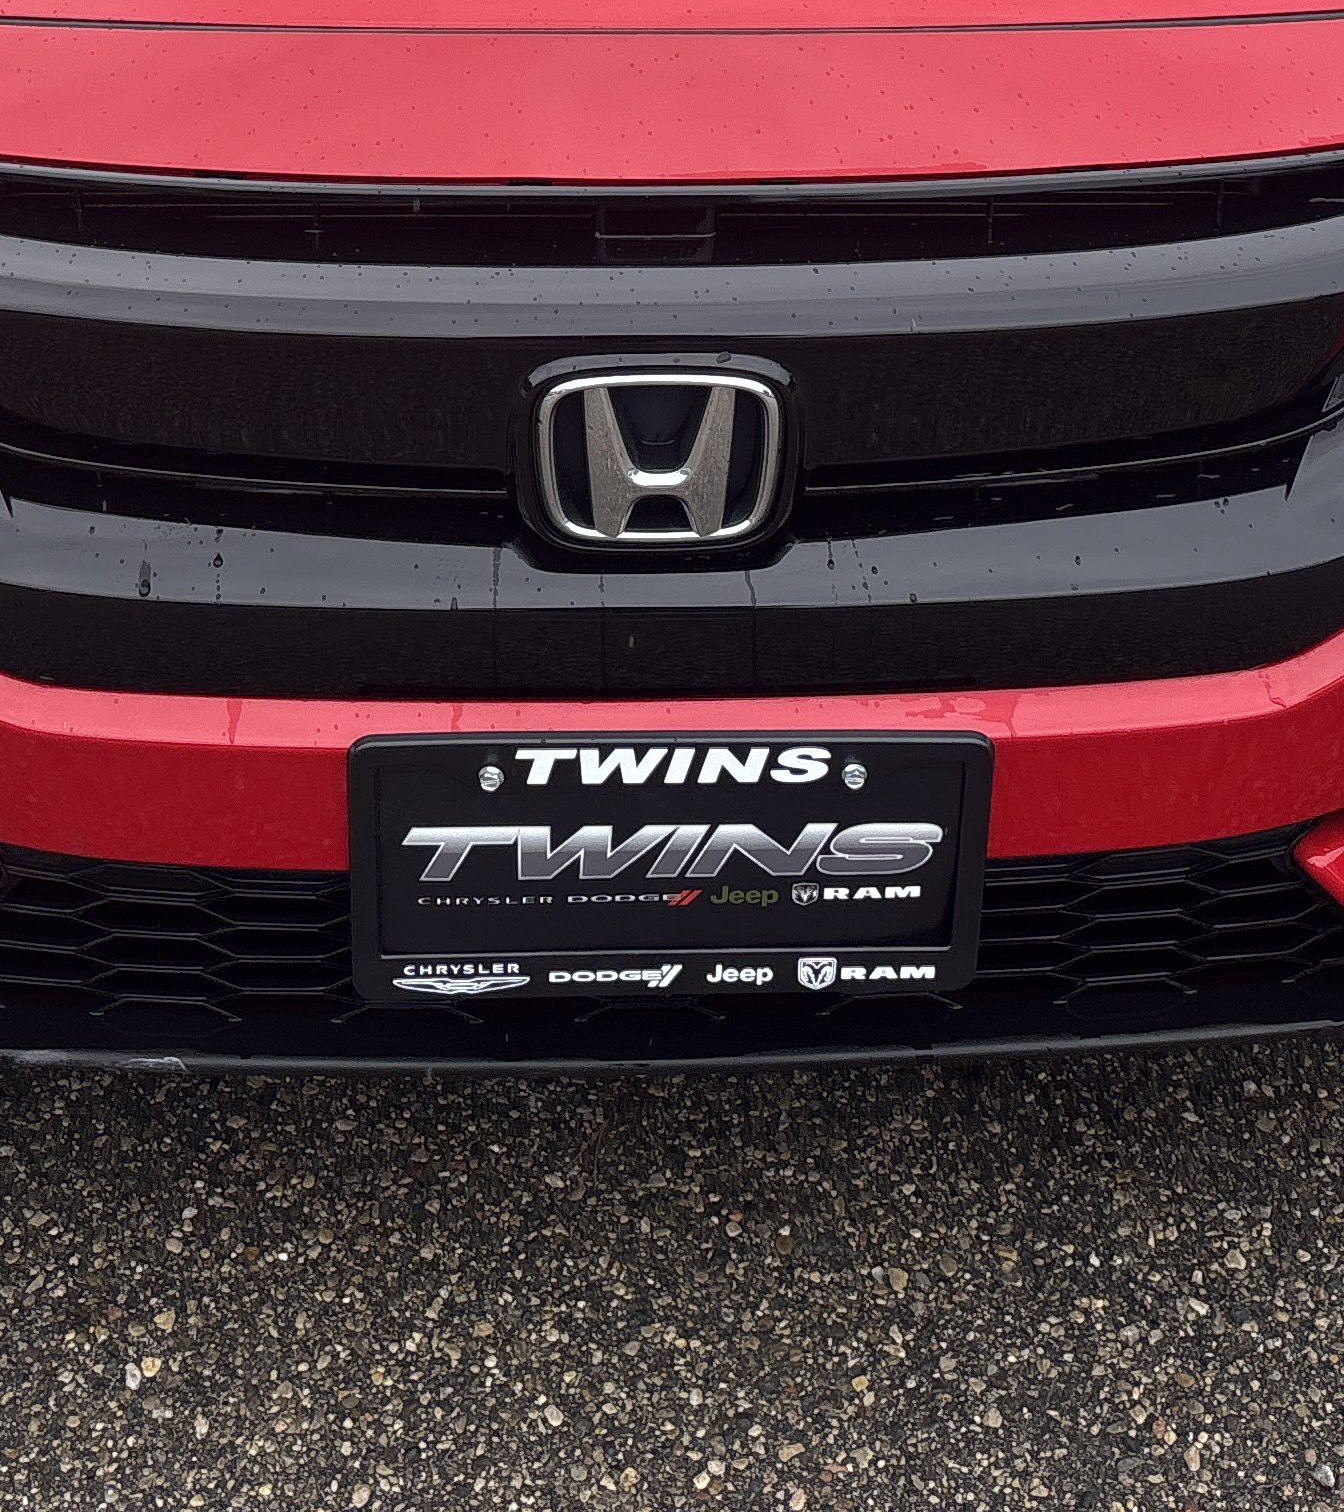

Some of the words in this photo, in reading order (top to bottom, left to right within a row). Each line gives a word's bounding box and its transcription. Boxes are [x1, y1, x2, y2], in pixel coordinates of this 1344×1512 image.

[515, 747, 832, 785] TWINS
[402, 823, 943, 881] TWINS
[417, 895, 554, 906] CHRYSLER
[567, 893, 681, 904] DODGE
[710, 886, 779, 907] Jeep
[823, 886, 921, 900] RAM
[403, 963, 520, 976] CHRYSLER
[548, 969, 665, 983] DODGE
[706, 964, 774, 986] Jeep
[840, 965, 936, 980] RAM
